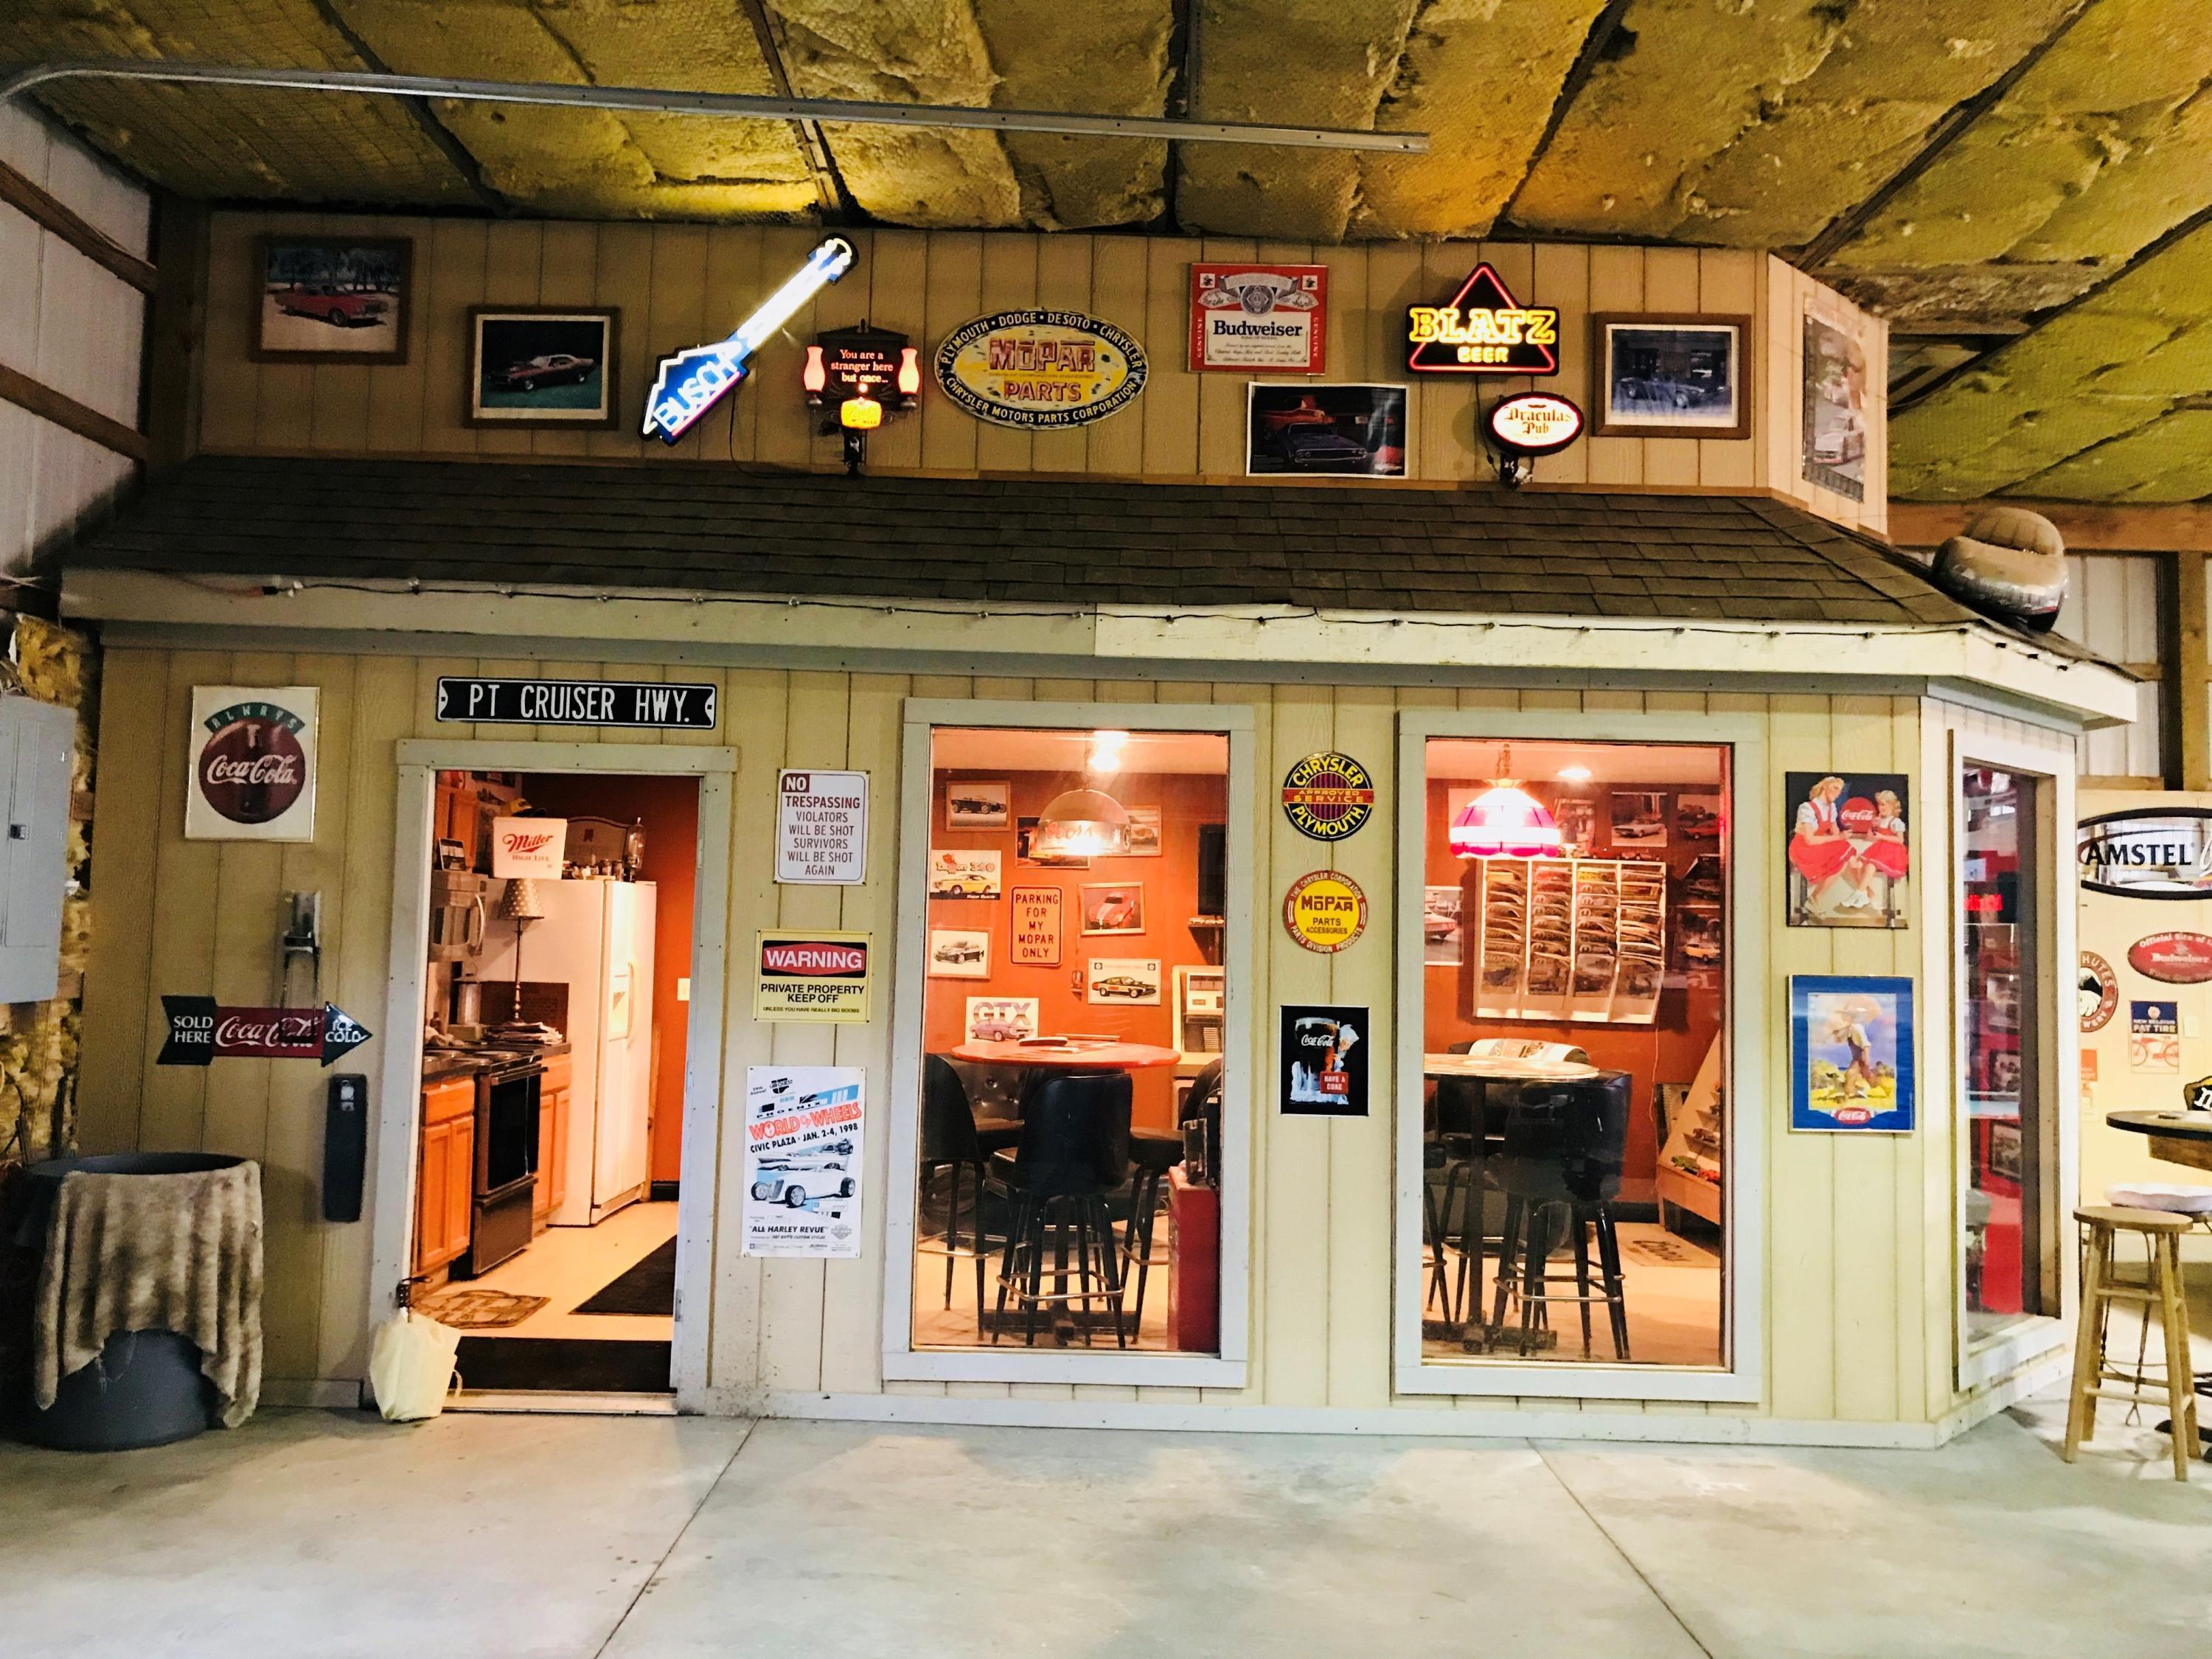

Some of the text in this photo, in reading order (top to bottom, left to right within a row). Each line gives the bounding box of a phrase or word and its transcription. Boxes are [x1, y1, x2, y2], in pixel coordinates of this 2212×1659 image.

[1213, 320, 1304, 337] Budweiser
[1409, 307, 1557, 345] BLATZ
[941, 313, 1142, 367] PLYMOUTH DODGE DESOTO CHRYSLER
[840, 349, 858, 360] You
[877, 352, 884, 361] a
[990, 339, 1095, 372] MOPAR
[1457, 346, 1509, 364] BEER
[830, 361, 894, 372] stranger here
[841, 372, 857, 382] but
[653, 349, 738, 433] BUSCH
[1004, 380, 1082, 401] PARTS
[946, 377, 1137, 423] CHRYSLER MOTORS PARTS CORPORATION
[1523, 422, 1549, 434] Pub
[469, 684, 690, 723] PT CRUISER HWY.
[212, 705, 297, 729] ALWAYS
[206, 754, 298, 785] Coca-Cola
[1293, 757, 1364, 787] CHRYSLER
[786, 776, 807, 791] NO
[785, 796, 860, 809] TRESPASSING
[1293, 795, 1364, 803] SERVICE
[796, 812, 848, 823] VIOLATORS
[1292, 805, 1365, 835] PLYMOUTH
[789, 824, 855, 836] WILL BE SHOT
[502, 833, 554, 853] Miller
[793, 838, 848, 849] SURVIVORS
[787, 851, 853, 863] WILL BE SHOT
[2085, 841, 2191, 866] AMSTEL
[805, 864, 835, 876] AGAIN
[1290, 872, 1363, 900] THE CHRYSLER CORPORATION
[1015, 894, 1059, 905] PARKING
[1026, 908, 1047, 918] FOR
[1029, 921, 1043, 931] MY
[1312, 918, 1341, 926] PARTS
[1306, 927, 1348, 935] ACCESSORIES
[1018, 934, 1054, 945] MOPAR
[1290, 925, 1363, 953] PARTS DIVISION PRODUCTS
[2139, 933, 2172, 947] Official
[766, 950, 862, 970] WARNING
[1023, 947, 1049, 959] ONLY
[2151, 953, 2211, 964] Budweiser
[2082, 955, 2114, 987] HUTES
[761, 984, 864, 995] PRIVATE PROPERTY
[787, 993, 839, 1004] KEEP OFF
[973, 1002, 1031, 1026] GTX
[2082, 1011, 2107, 1029] WERY
[173, 1016, 213, 1029] SOLD
[333, 1018, 353, 1032] ICE
[174, 1031, 211, 1044] HERE
[325, 1032, 361, 1043] COLD
[1301, 1034, 1335, 1047] Coca-Cola
[757, 1102, 821, 1119] PHOENIX
[748, 1116, 800, 1141] WORLD
[810, 1102, 862, 1127] WHEELS
[751, 1123, 858, 1153] CIVIC PLAZA JAN. 2-4, 1998
